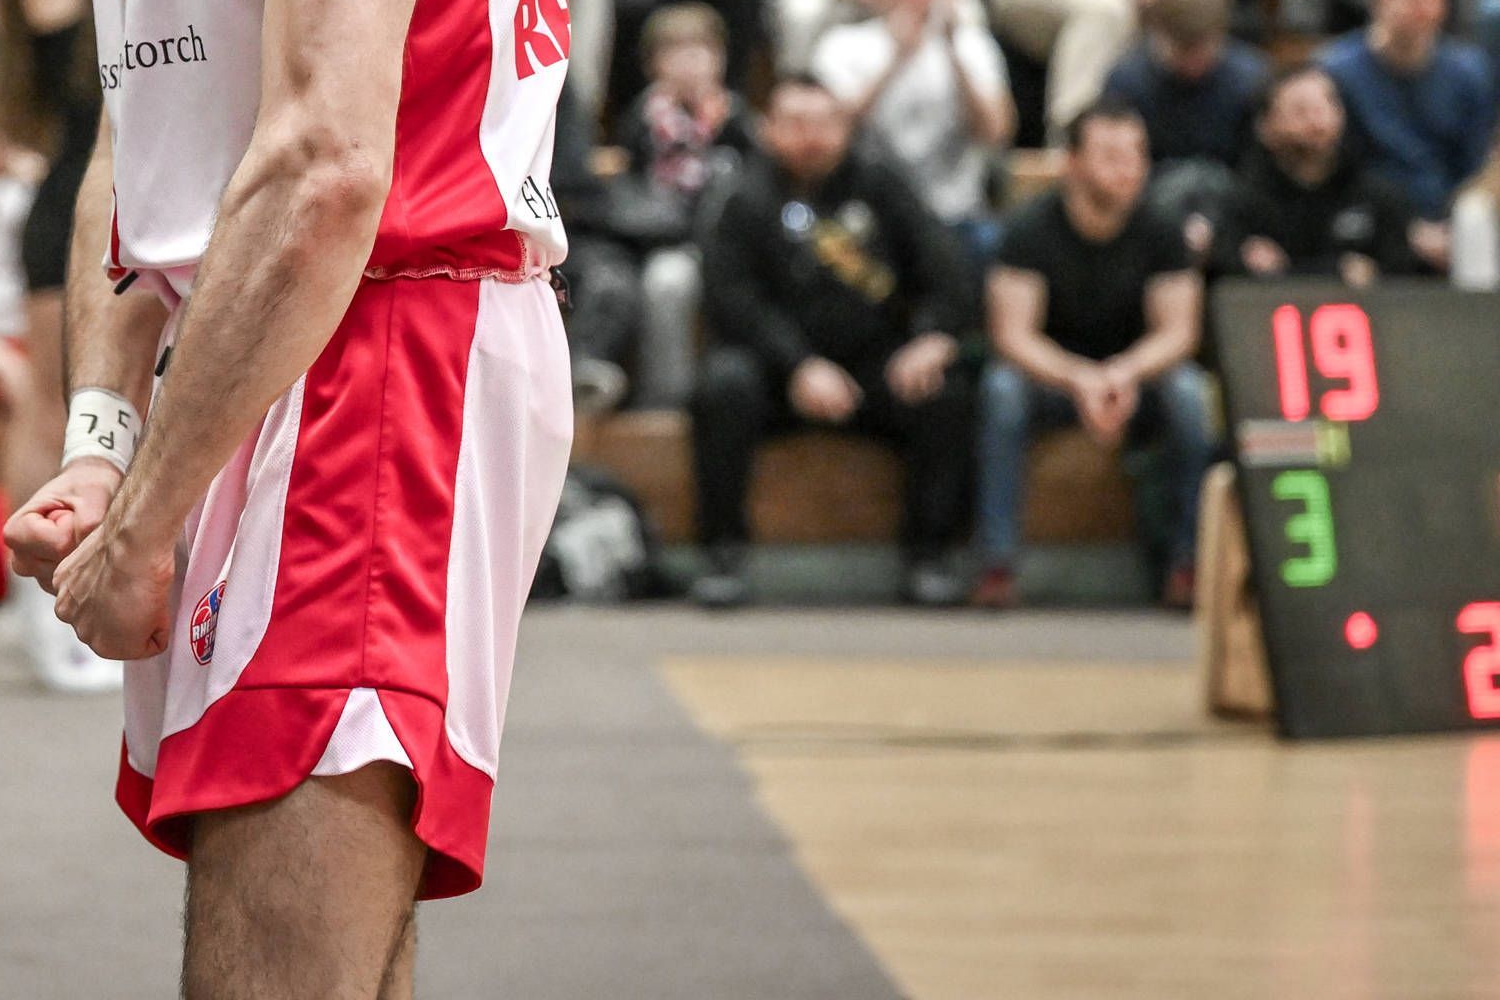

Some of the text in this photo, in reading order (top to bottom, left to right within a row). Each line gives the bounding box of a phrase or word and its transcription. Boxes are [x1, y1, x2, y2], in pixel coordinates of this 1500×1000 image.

[124, 24, 208, 70] torch
[1272, 303, 1380, 422] 19
[1270, 469, 1338, 588] 3
